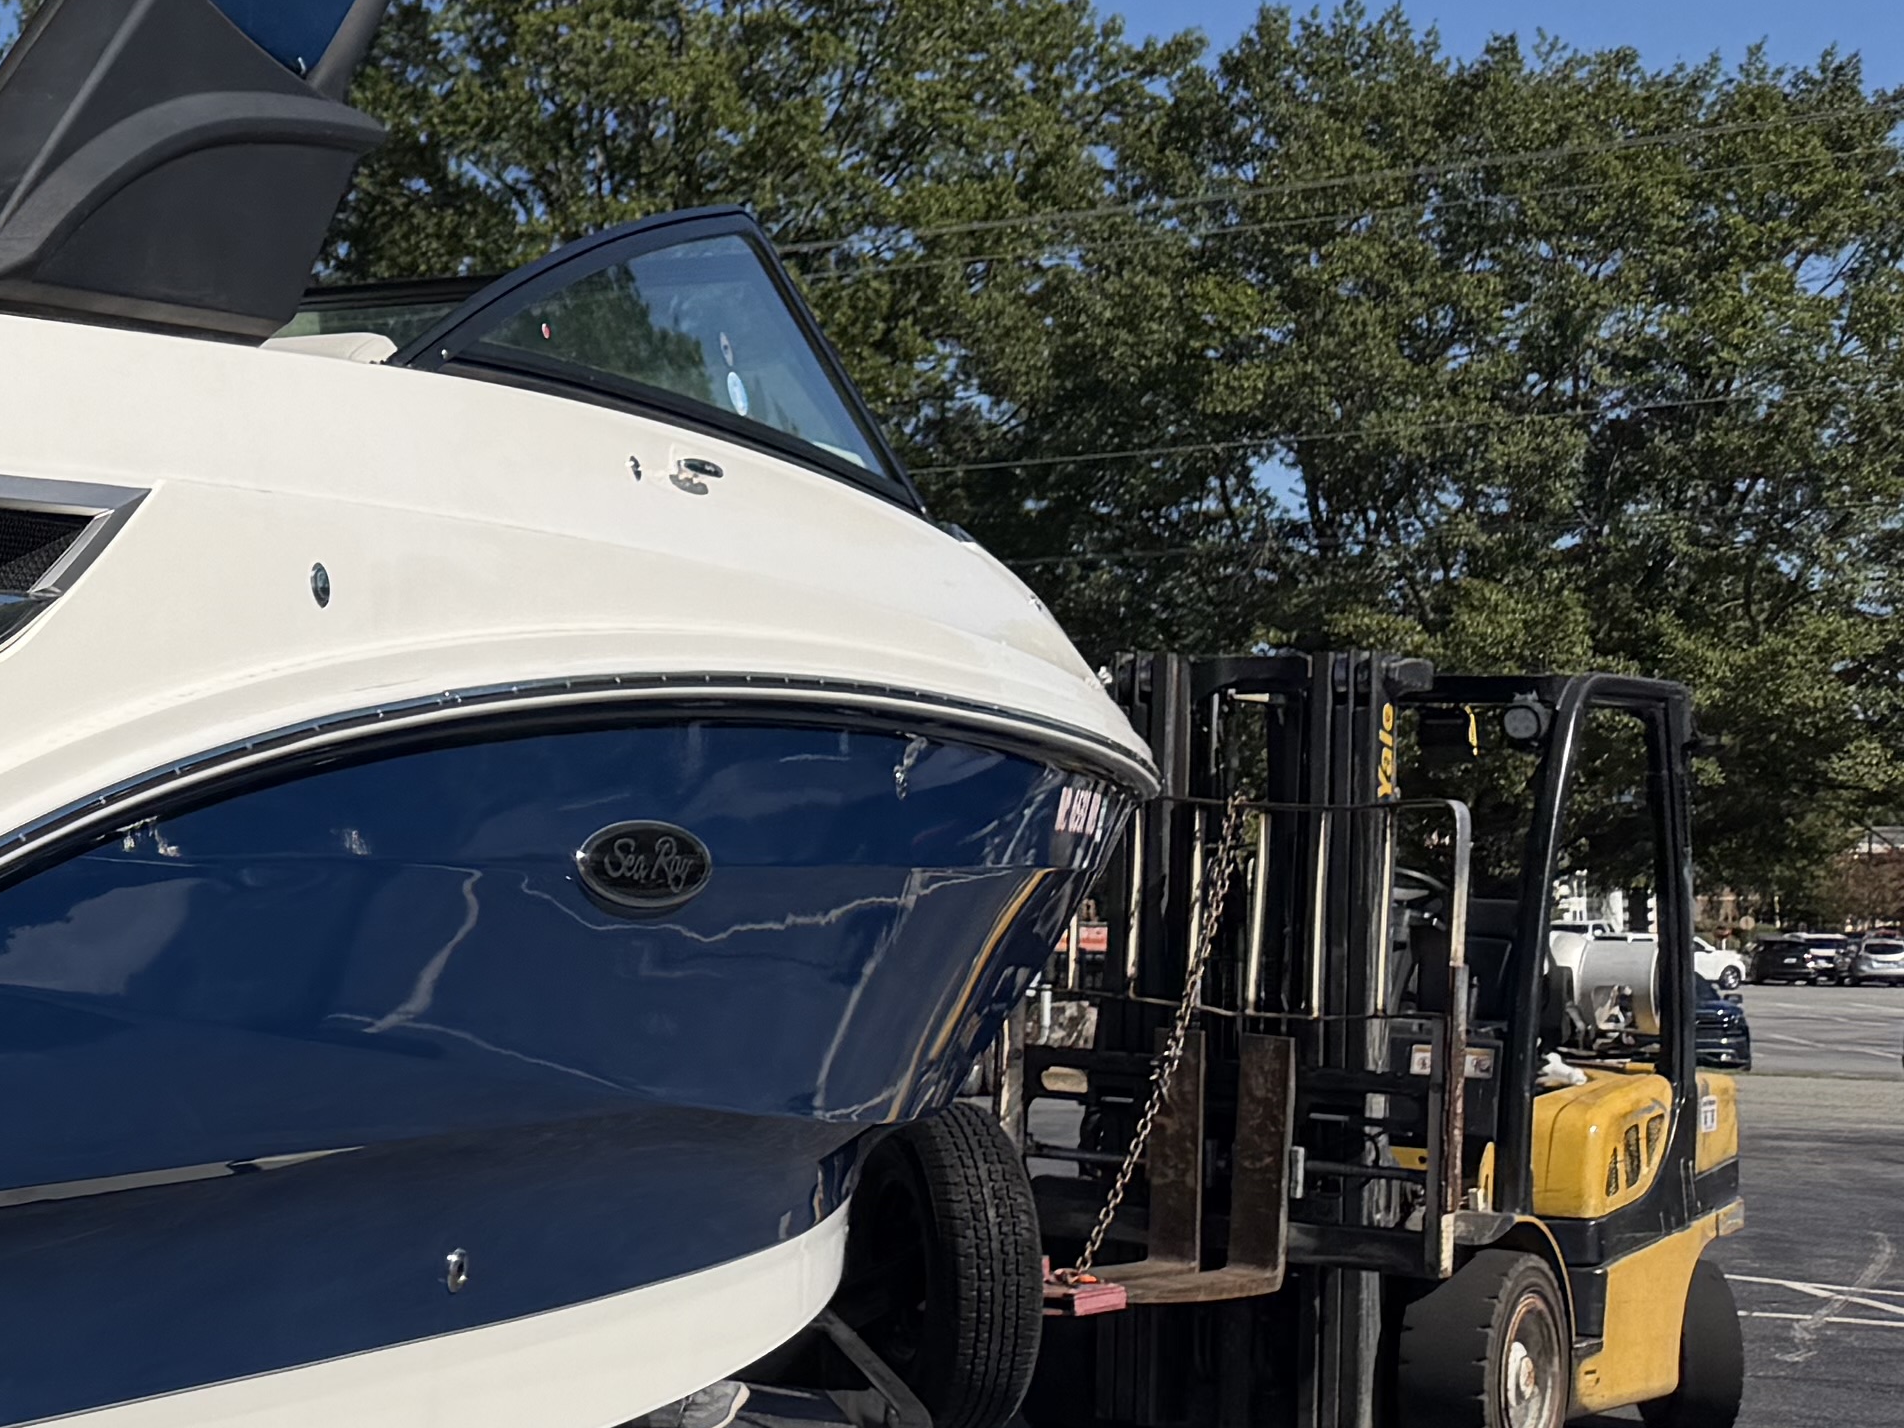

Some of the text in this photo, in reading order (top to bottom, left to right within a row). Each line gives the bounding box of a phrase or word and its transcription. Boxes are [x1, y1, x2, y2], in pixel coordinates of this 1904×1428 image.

[1376, 703, 1394, 798] Yale
[604, 835, 696, 892] Sea Ray
